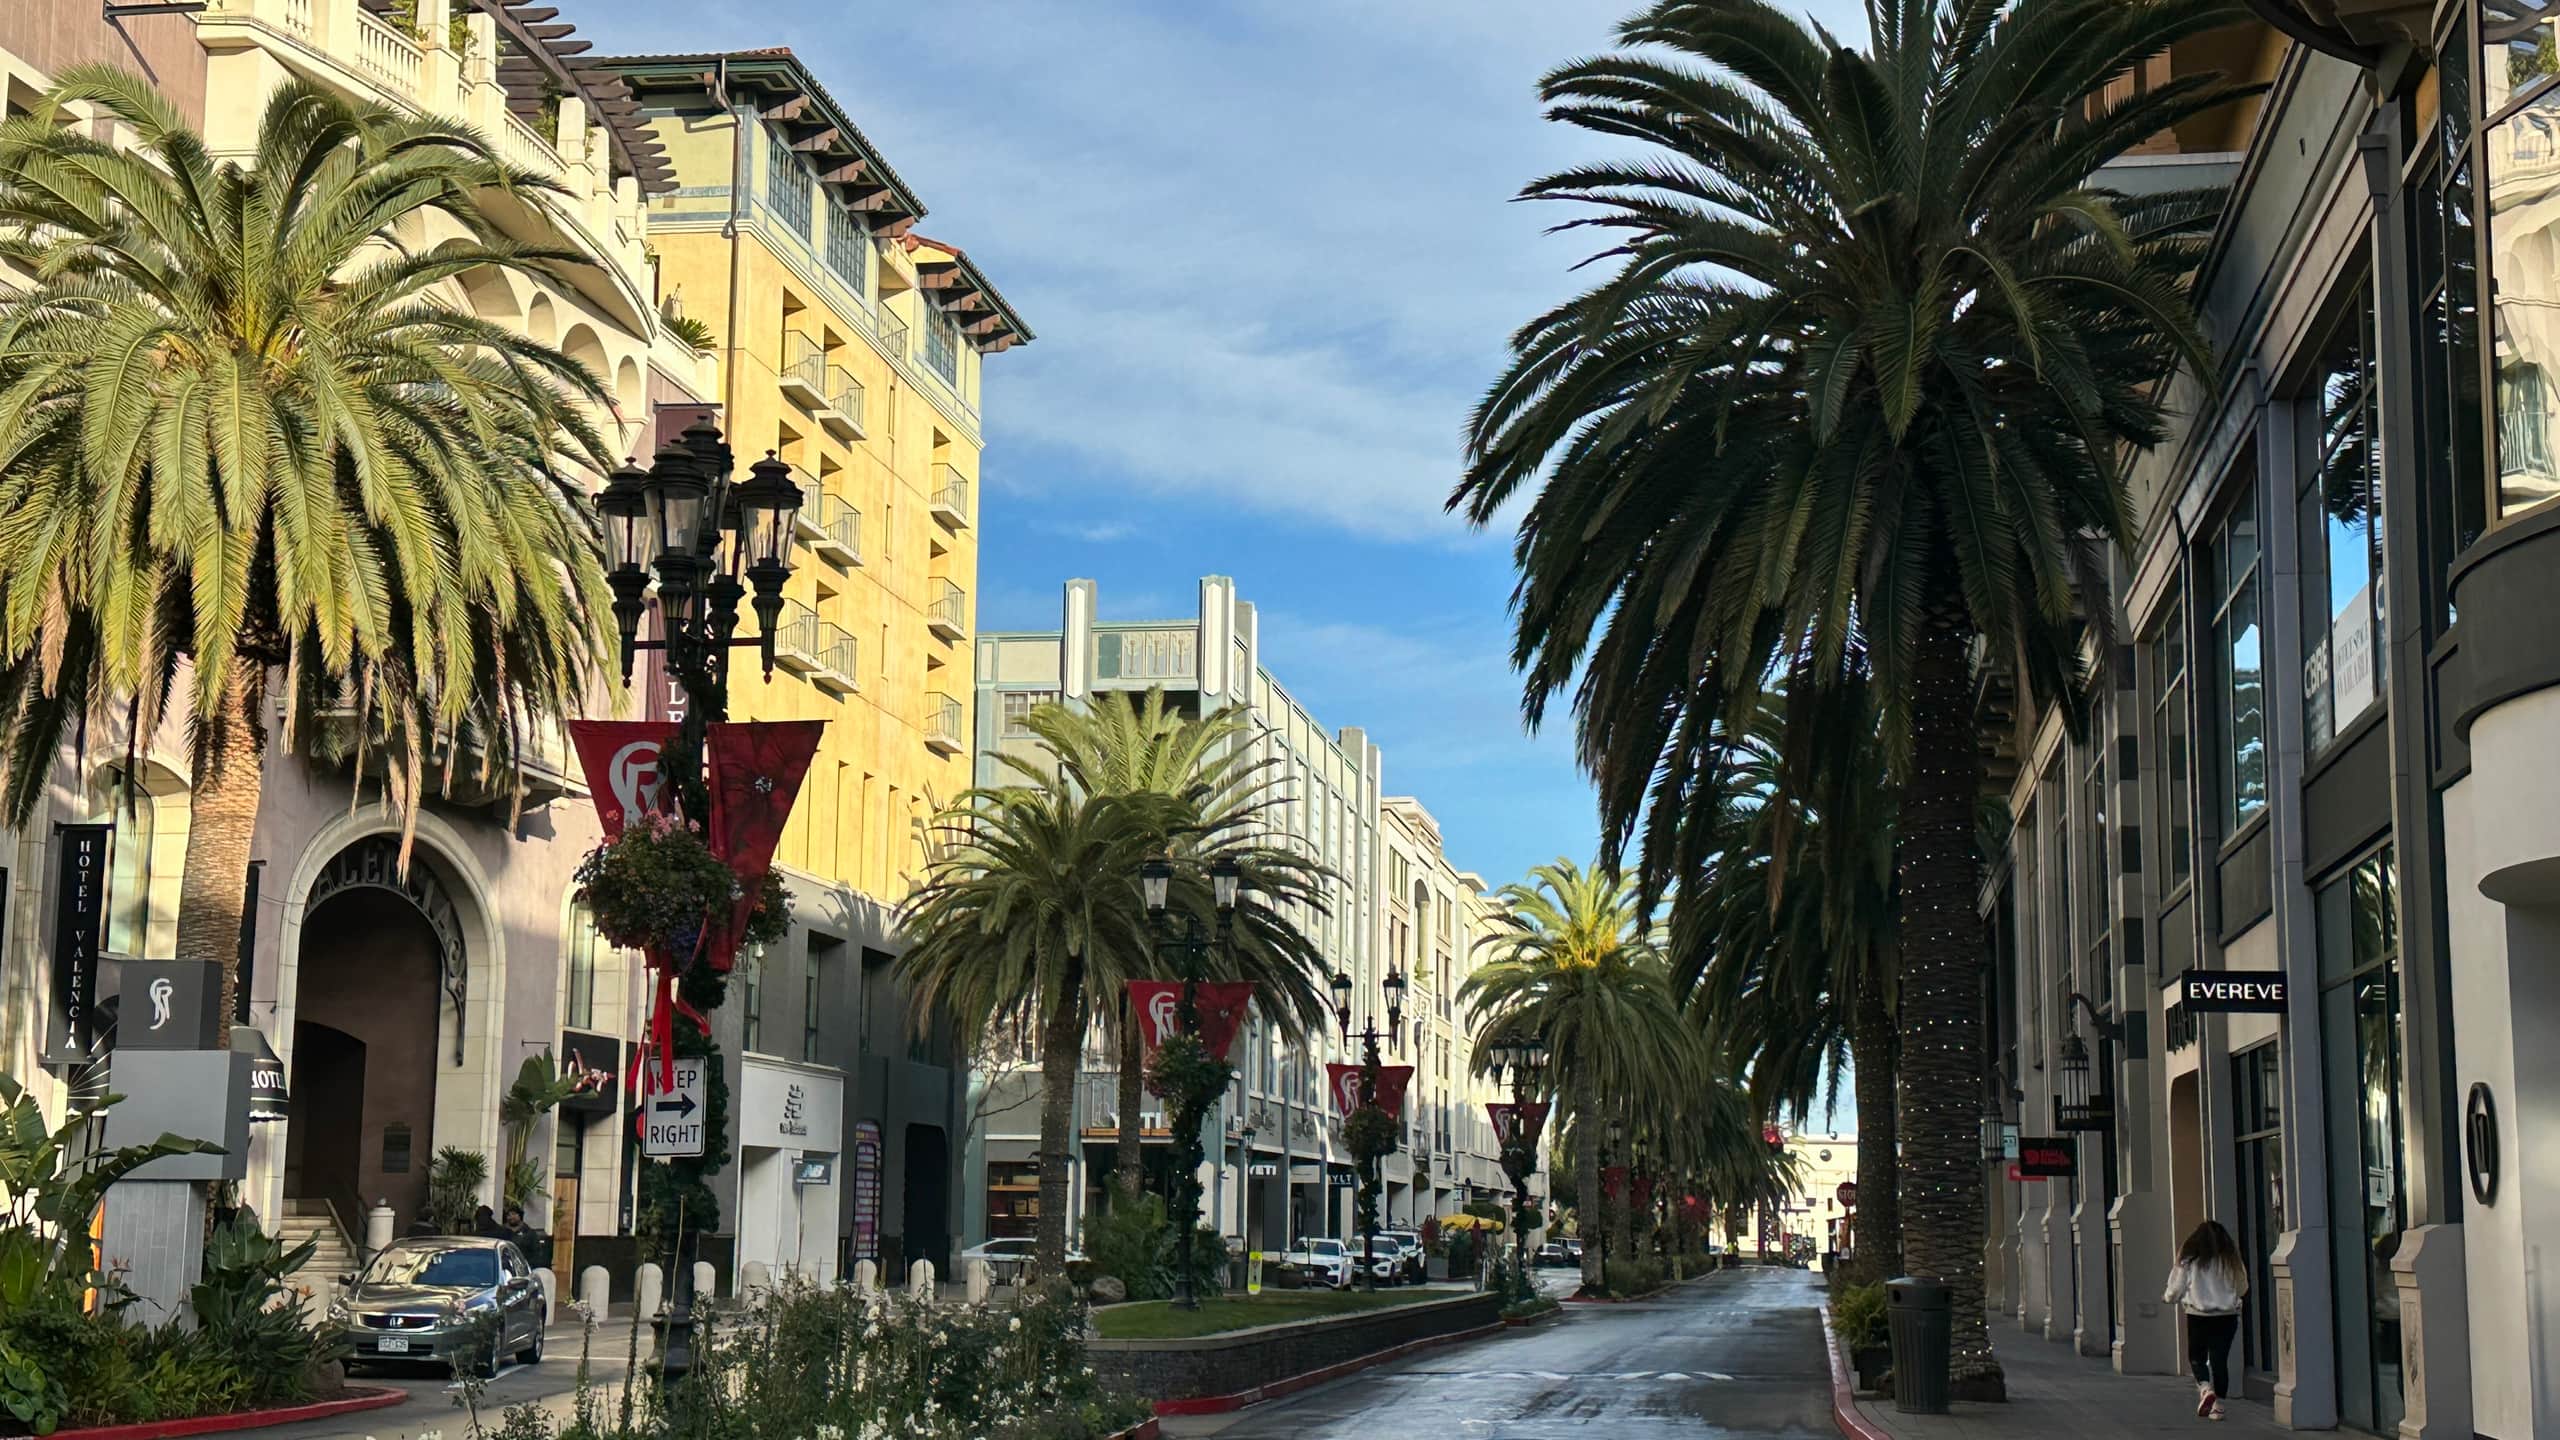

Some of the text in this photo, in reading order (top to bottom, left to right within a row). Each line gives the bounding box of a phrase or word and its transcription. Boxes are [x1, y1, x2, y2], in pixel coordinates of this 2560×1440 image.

[2304, 638, 2329, 699] CBRE
[64, 840, 91, 1049] HOTEL VALENCIA
[2189, 982, 2283, 1000] EVEREVE
[656, 1069, 697, 1089] KEP
[1110, 1112, 1161, 1129] YTI
[650, 1124, 699, 1144] RIGHT
